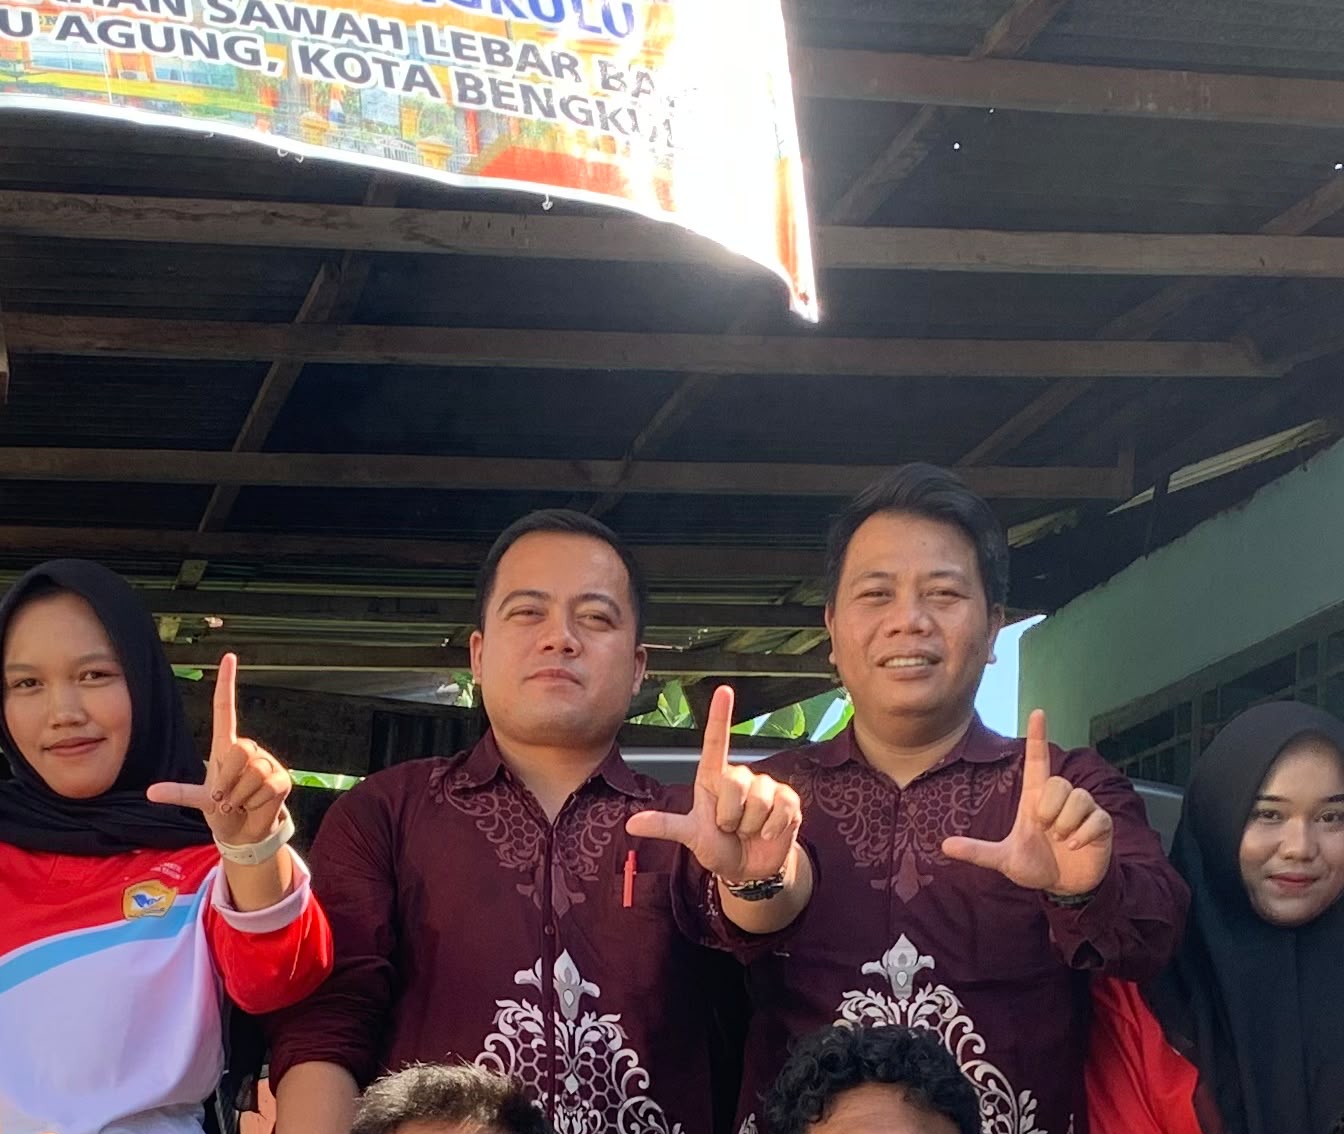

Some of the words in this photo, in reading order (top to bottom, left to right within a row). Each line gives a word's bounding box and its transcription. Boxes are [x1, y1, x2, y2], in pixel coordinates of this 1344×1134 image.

[55, 15, 278, 72] AGUNG,
[298, 44, 441, 98] KOTA
[209, 0, 404, 50] SAWAH
[422, 24, 582, 83] LEBAR
